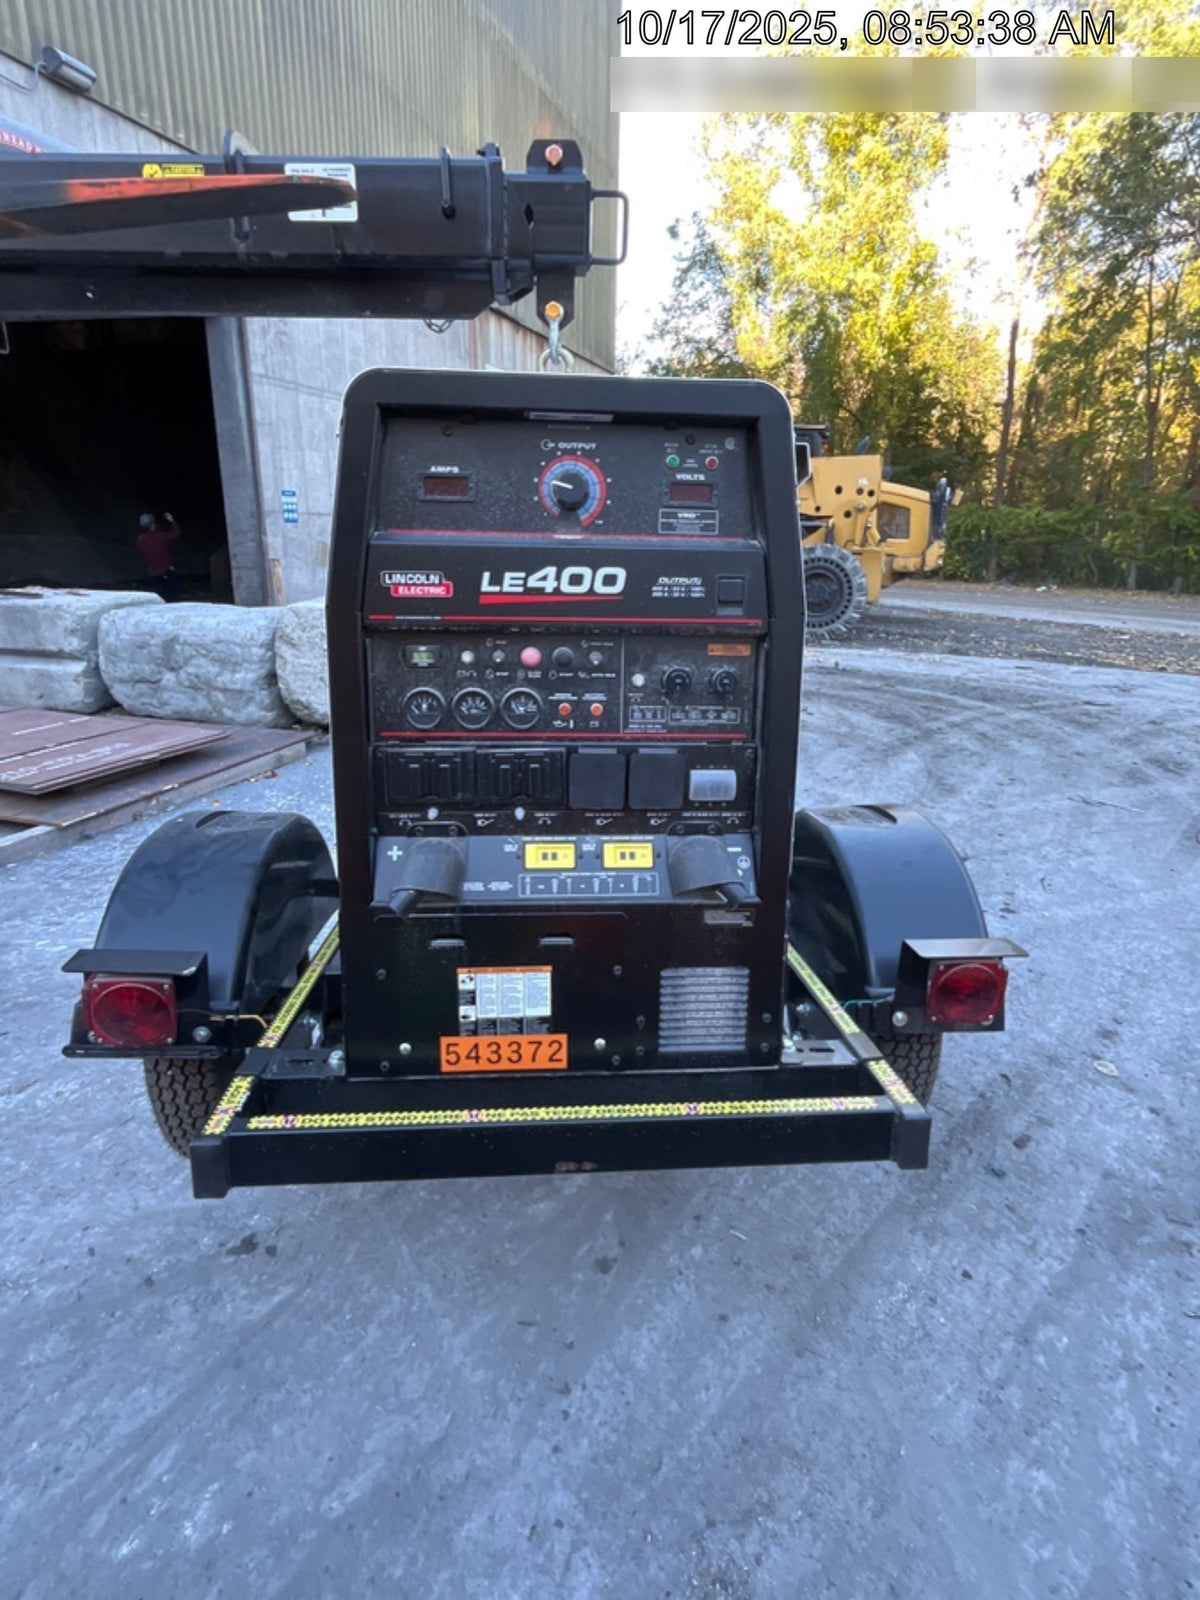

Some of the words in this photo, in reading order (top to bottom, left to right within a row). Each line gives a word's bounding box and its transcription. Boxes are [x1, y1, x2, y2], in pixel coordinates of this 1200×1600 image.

[557, 442, 597, 450] OUTPUT
[675, 473, 705, 481] VOLTS
[385, 573, 440, 584] LINCOLN
[480, 566, 627, 593] LE400
[397, 586, 447, 595] ELECTRIC
[445, 1040, 563, 1066] 543372
[300, 1116, 326, 1126] DO
[328, 1115, 361, 1125] NOT
[365, 1113, 418, 1123] STAND
[421, 1111, 464, 1121] HERE
